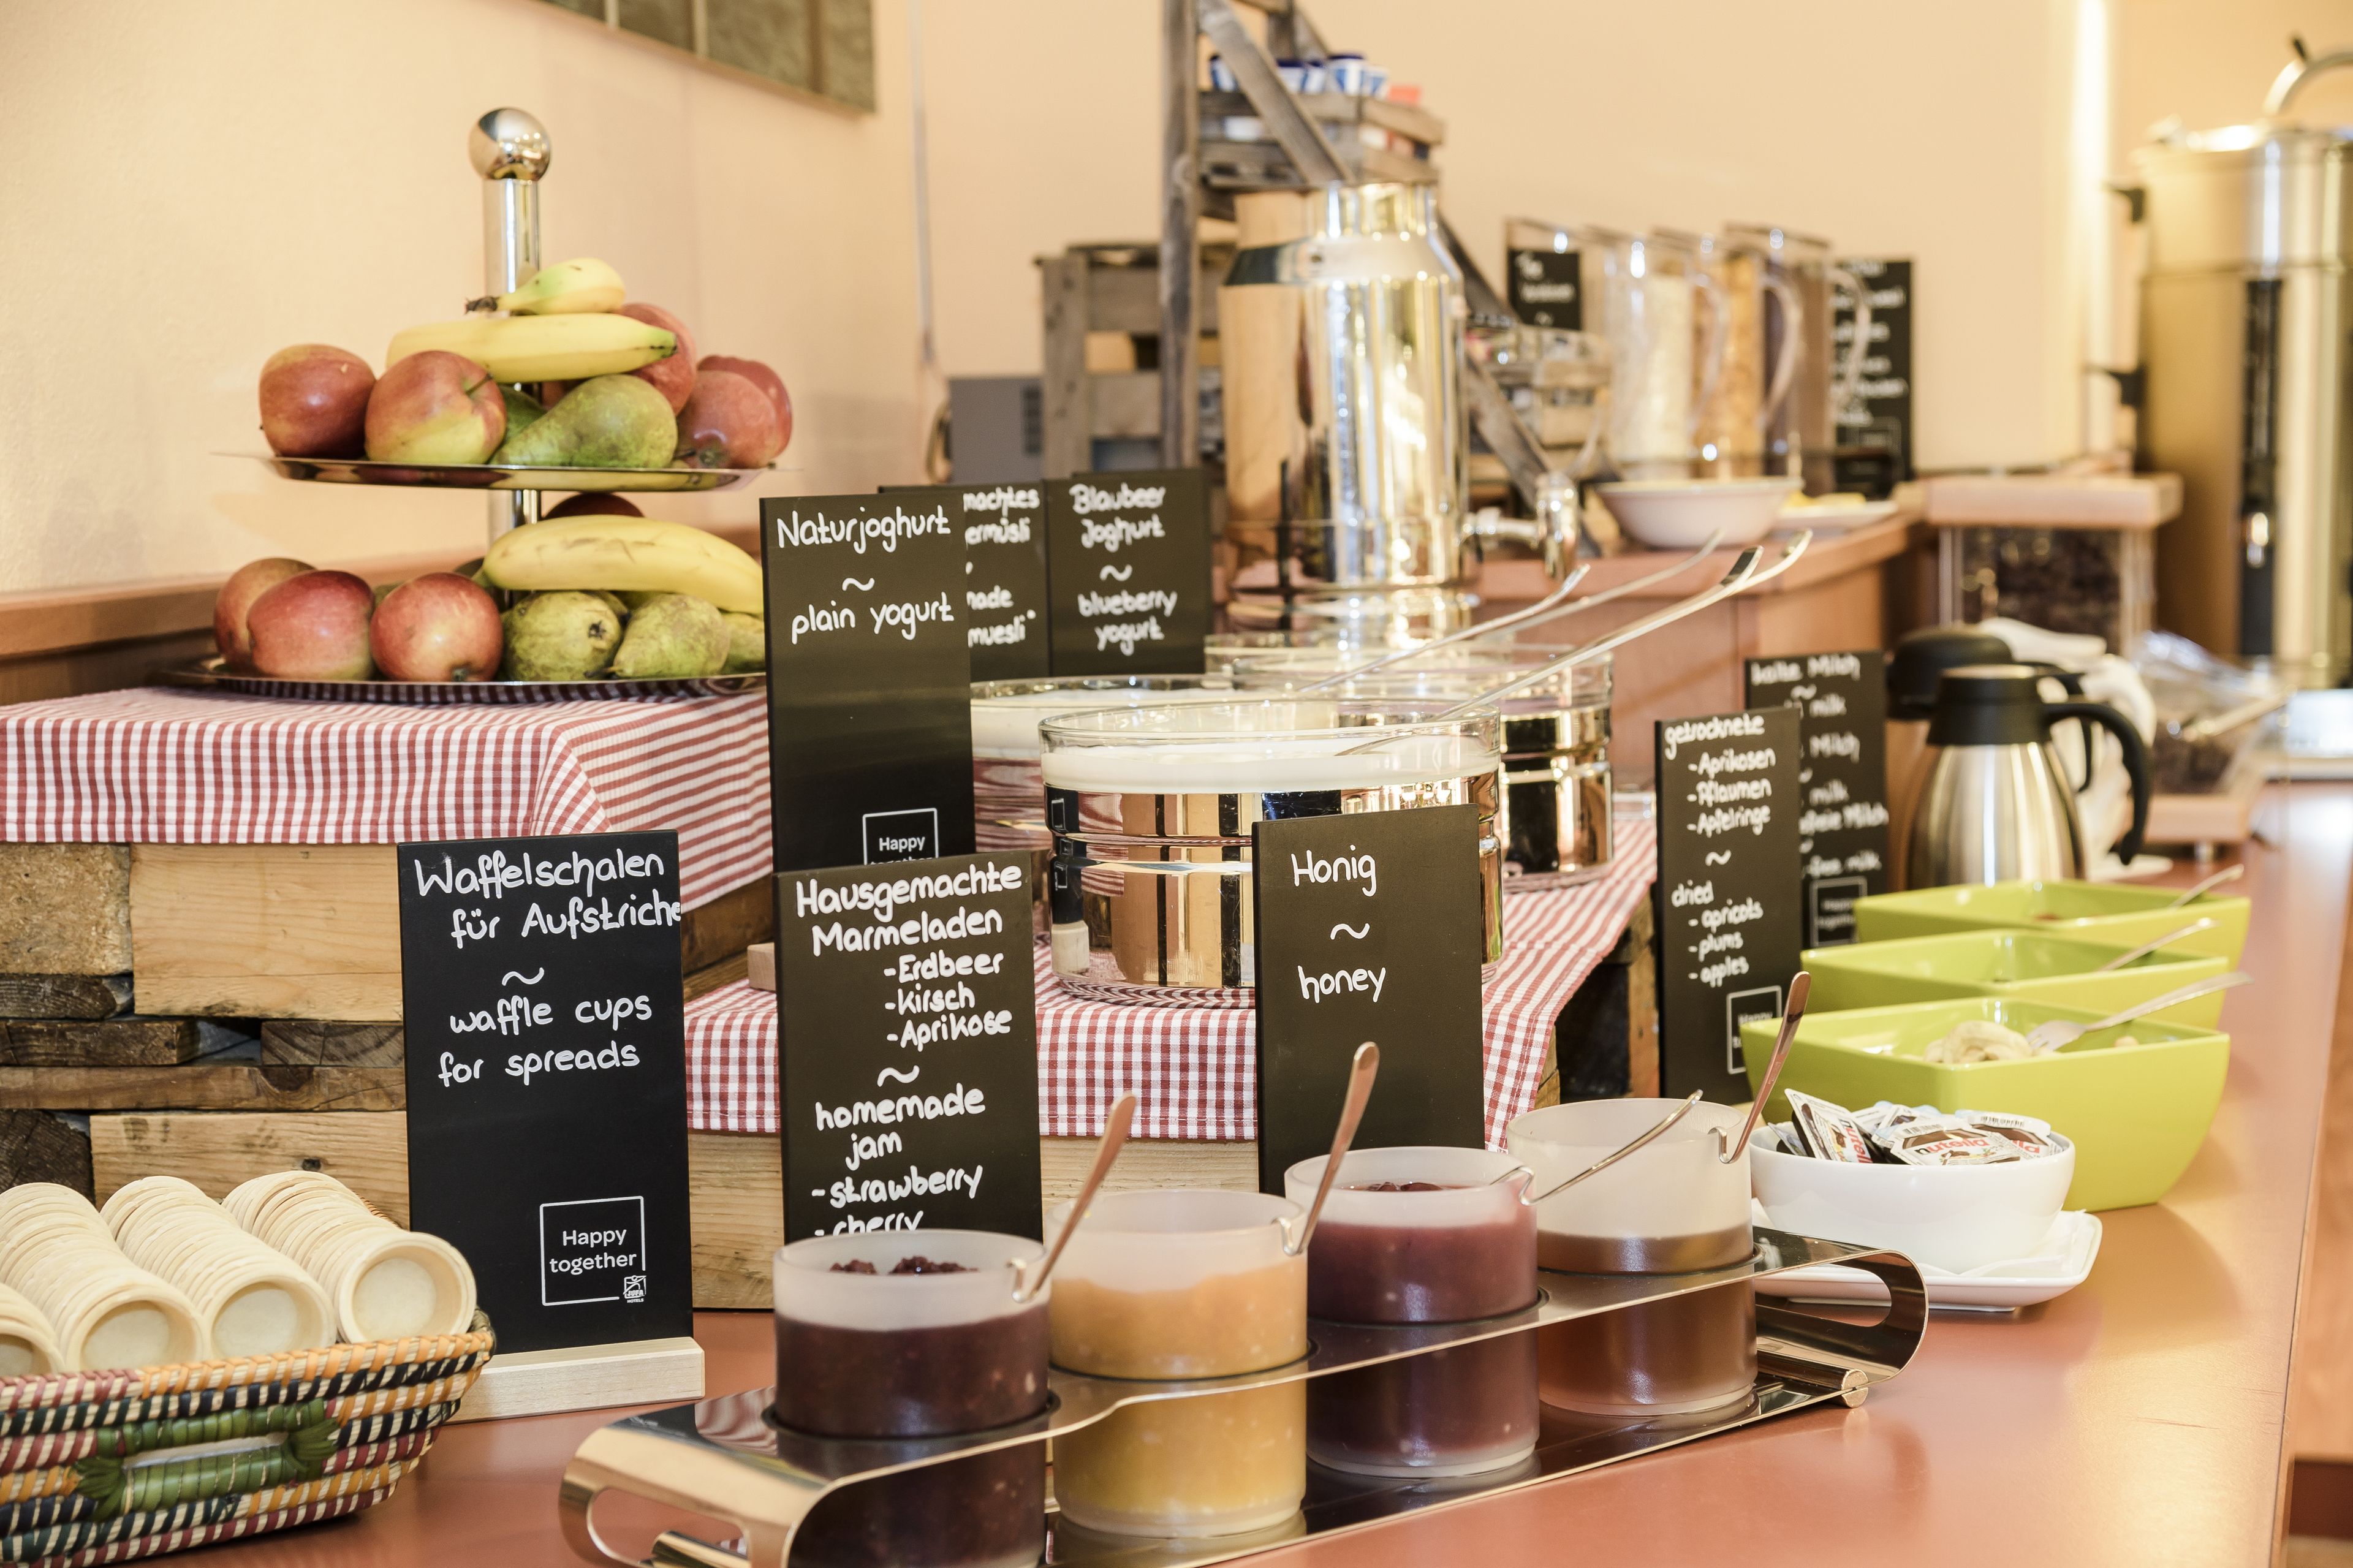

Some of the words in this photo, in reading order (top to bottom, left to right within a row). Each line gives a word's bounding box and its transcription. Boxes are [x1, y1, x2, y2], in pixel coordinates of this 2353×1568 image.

[963, 485, 1040, 518] machtes
[1069, 482, 1166, 515] Blaubeer
[776, 504, 952, 555] Naturjoghurt
[964, 517, 1031, 547] ermüsli
[1081, 513, 1165, 553] Joghurt
[791, 600, 856, 645] plain
[870, 591, 955, 640] yogurt
[1077, 589, 1178, 617] blueberry
[1094, 616, 1165, 656] yogurt
[879, 836, 925, 853] Happy
[414, 848, 664, 900] Waffelschalen
[1290, 844, 1377, 897] Honig
[796, 862, 1022, 922] Hausgemachte
[1671, 879, 1715, 907] dried
[450, 908, 501, 949] für
[521, 888, 681, 940] Aufstriche
[811, 906, 1003, 957] Marmeladen
[883, 949, 1004, 983] -Erdbeer
[1297, 965, 1386, 1004] honey
[450, 994, 553, 1036] waffle
[575, 995, 652, 1031] cups
[886, 1010, 1012, 1052] -Aprikose
[438, 1051, 484, 1088] for
[504, 1040, 640, 1086] spreads
[815, 1082, 986, 1131] homemade
[845, 1131, 903, 1171] jam
[1914, 1138, 1990, 1156] nutella
[562, 1229, 627, 1249] Happy
[549, 1252, 637, 1276] together
